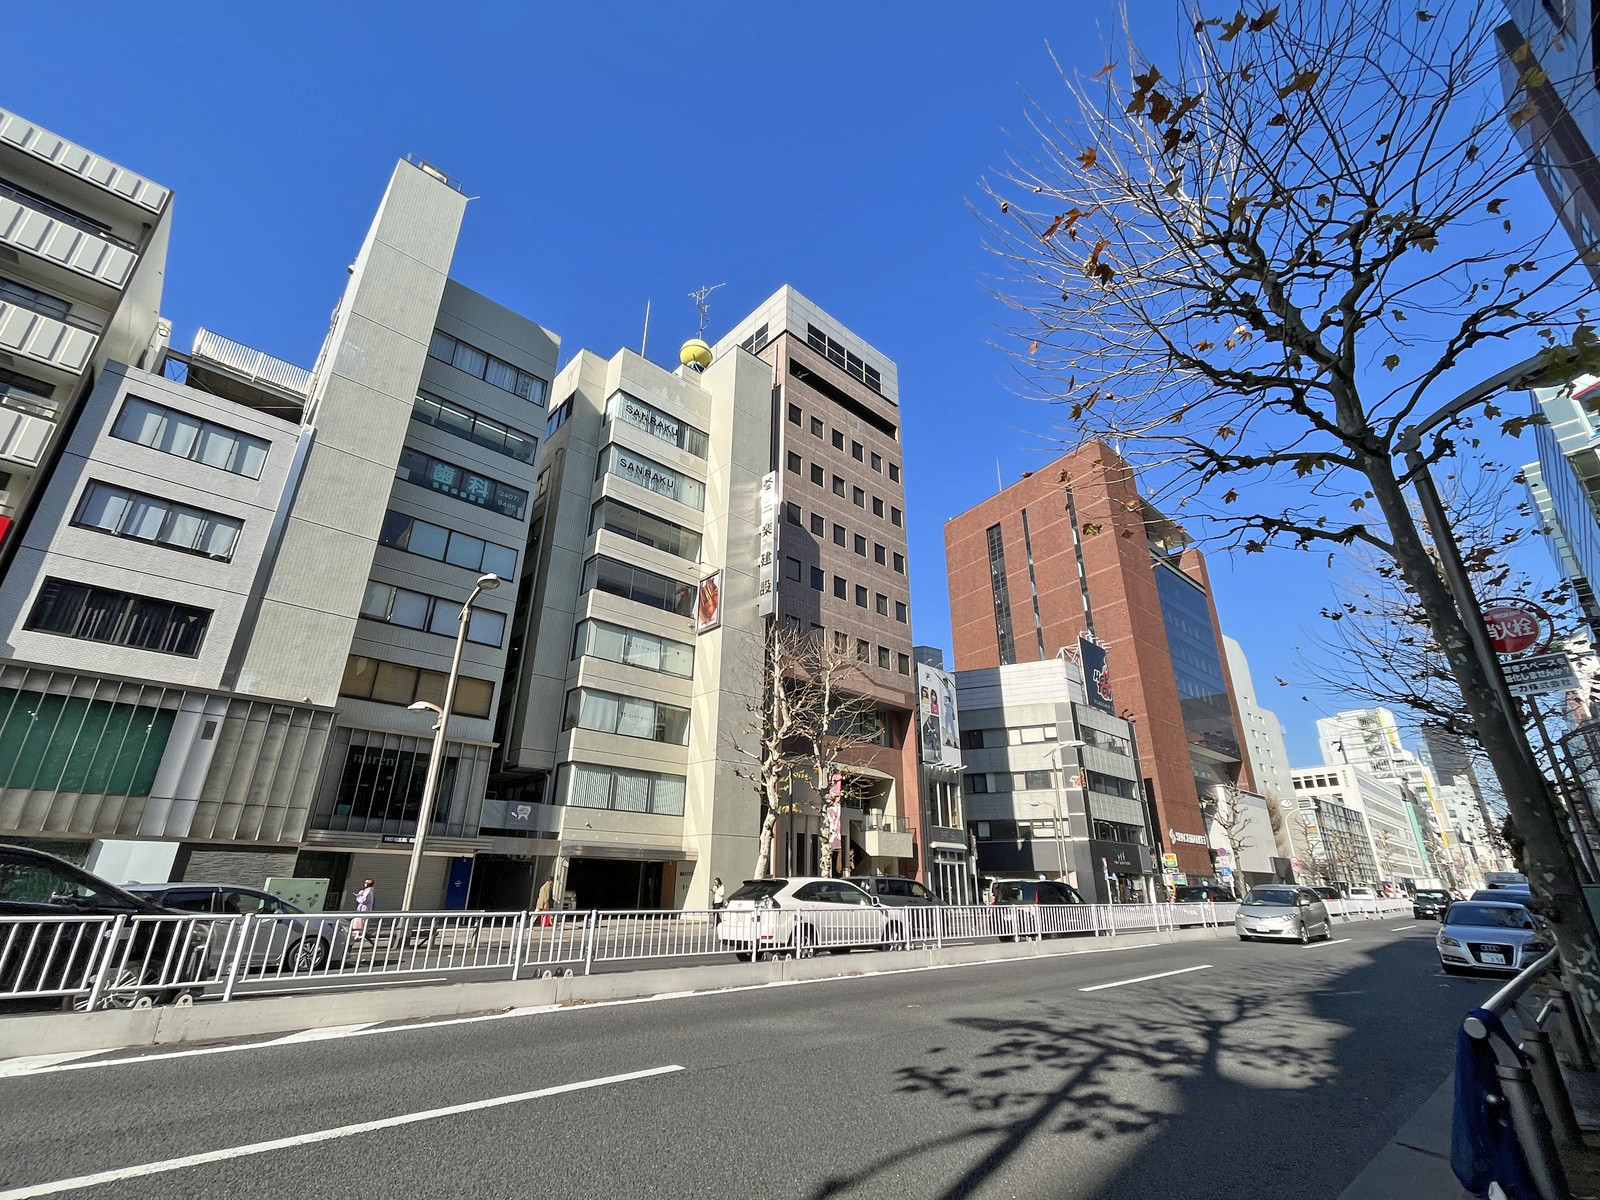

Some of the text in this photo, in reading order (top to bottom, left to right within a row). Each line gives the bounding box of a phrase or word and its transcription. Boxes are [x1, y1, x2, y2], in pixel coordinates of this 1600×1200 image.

[625, 404, 679, 436] SANRAKU
[432, 464, 489, 498] 歯科
[619, 458, 674, 488] SANRAKU
